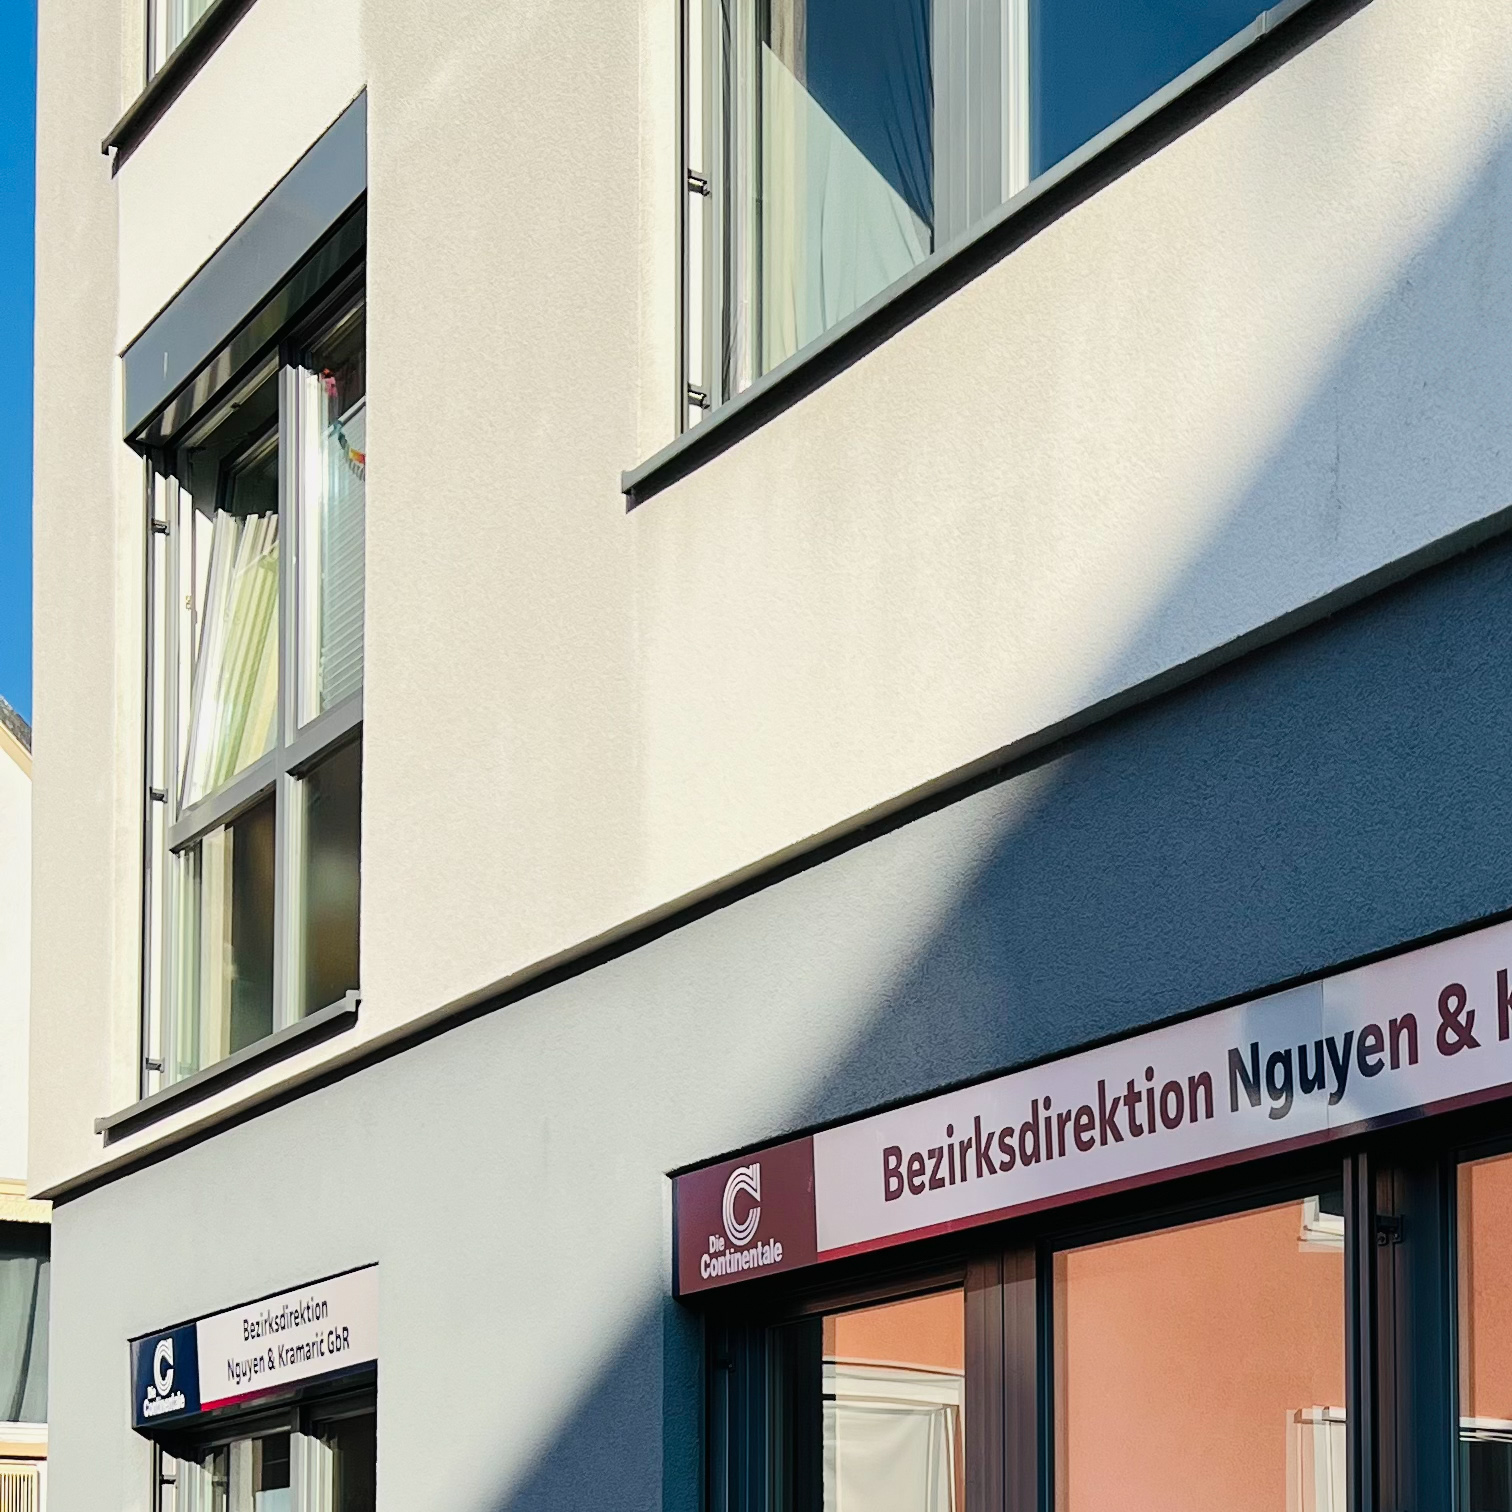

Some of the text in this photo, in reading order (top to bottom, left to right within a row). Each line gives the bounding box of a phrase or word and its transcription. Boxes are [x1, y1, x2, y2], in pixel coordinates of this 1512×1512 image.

[883, 1066, 1214, 1203] Bezirksdirektion
[1228, 1011, 1419, 1121] Nguyen
[1436, 983, 1482, 1057] &
[700, 1238, 783, 1279] Continentale
[708, 1234, 725, 1254] Die
[243, 1296, 329, 1342] Bezirksdirektion
[227, 1326, 350, 1385] Nguyen & Kramarić GbR
